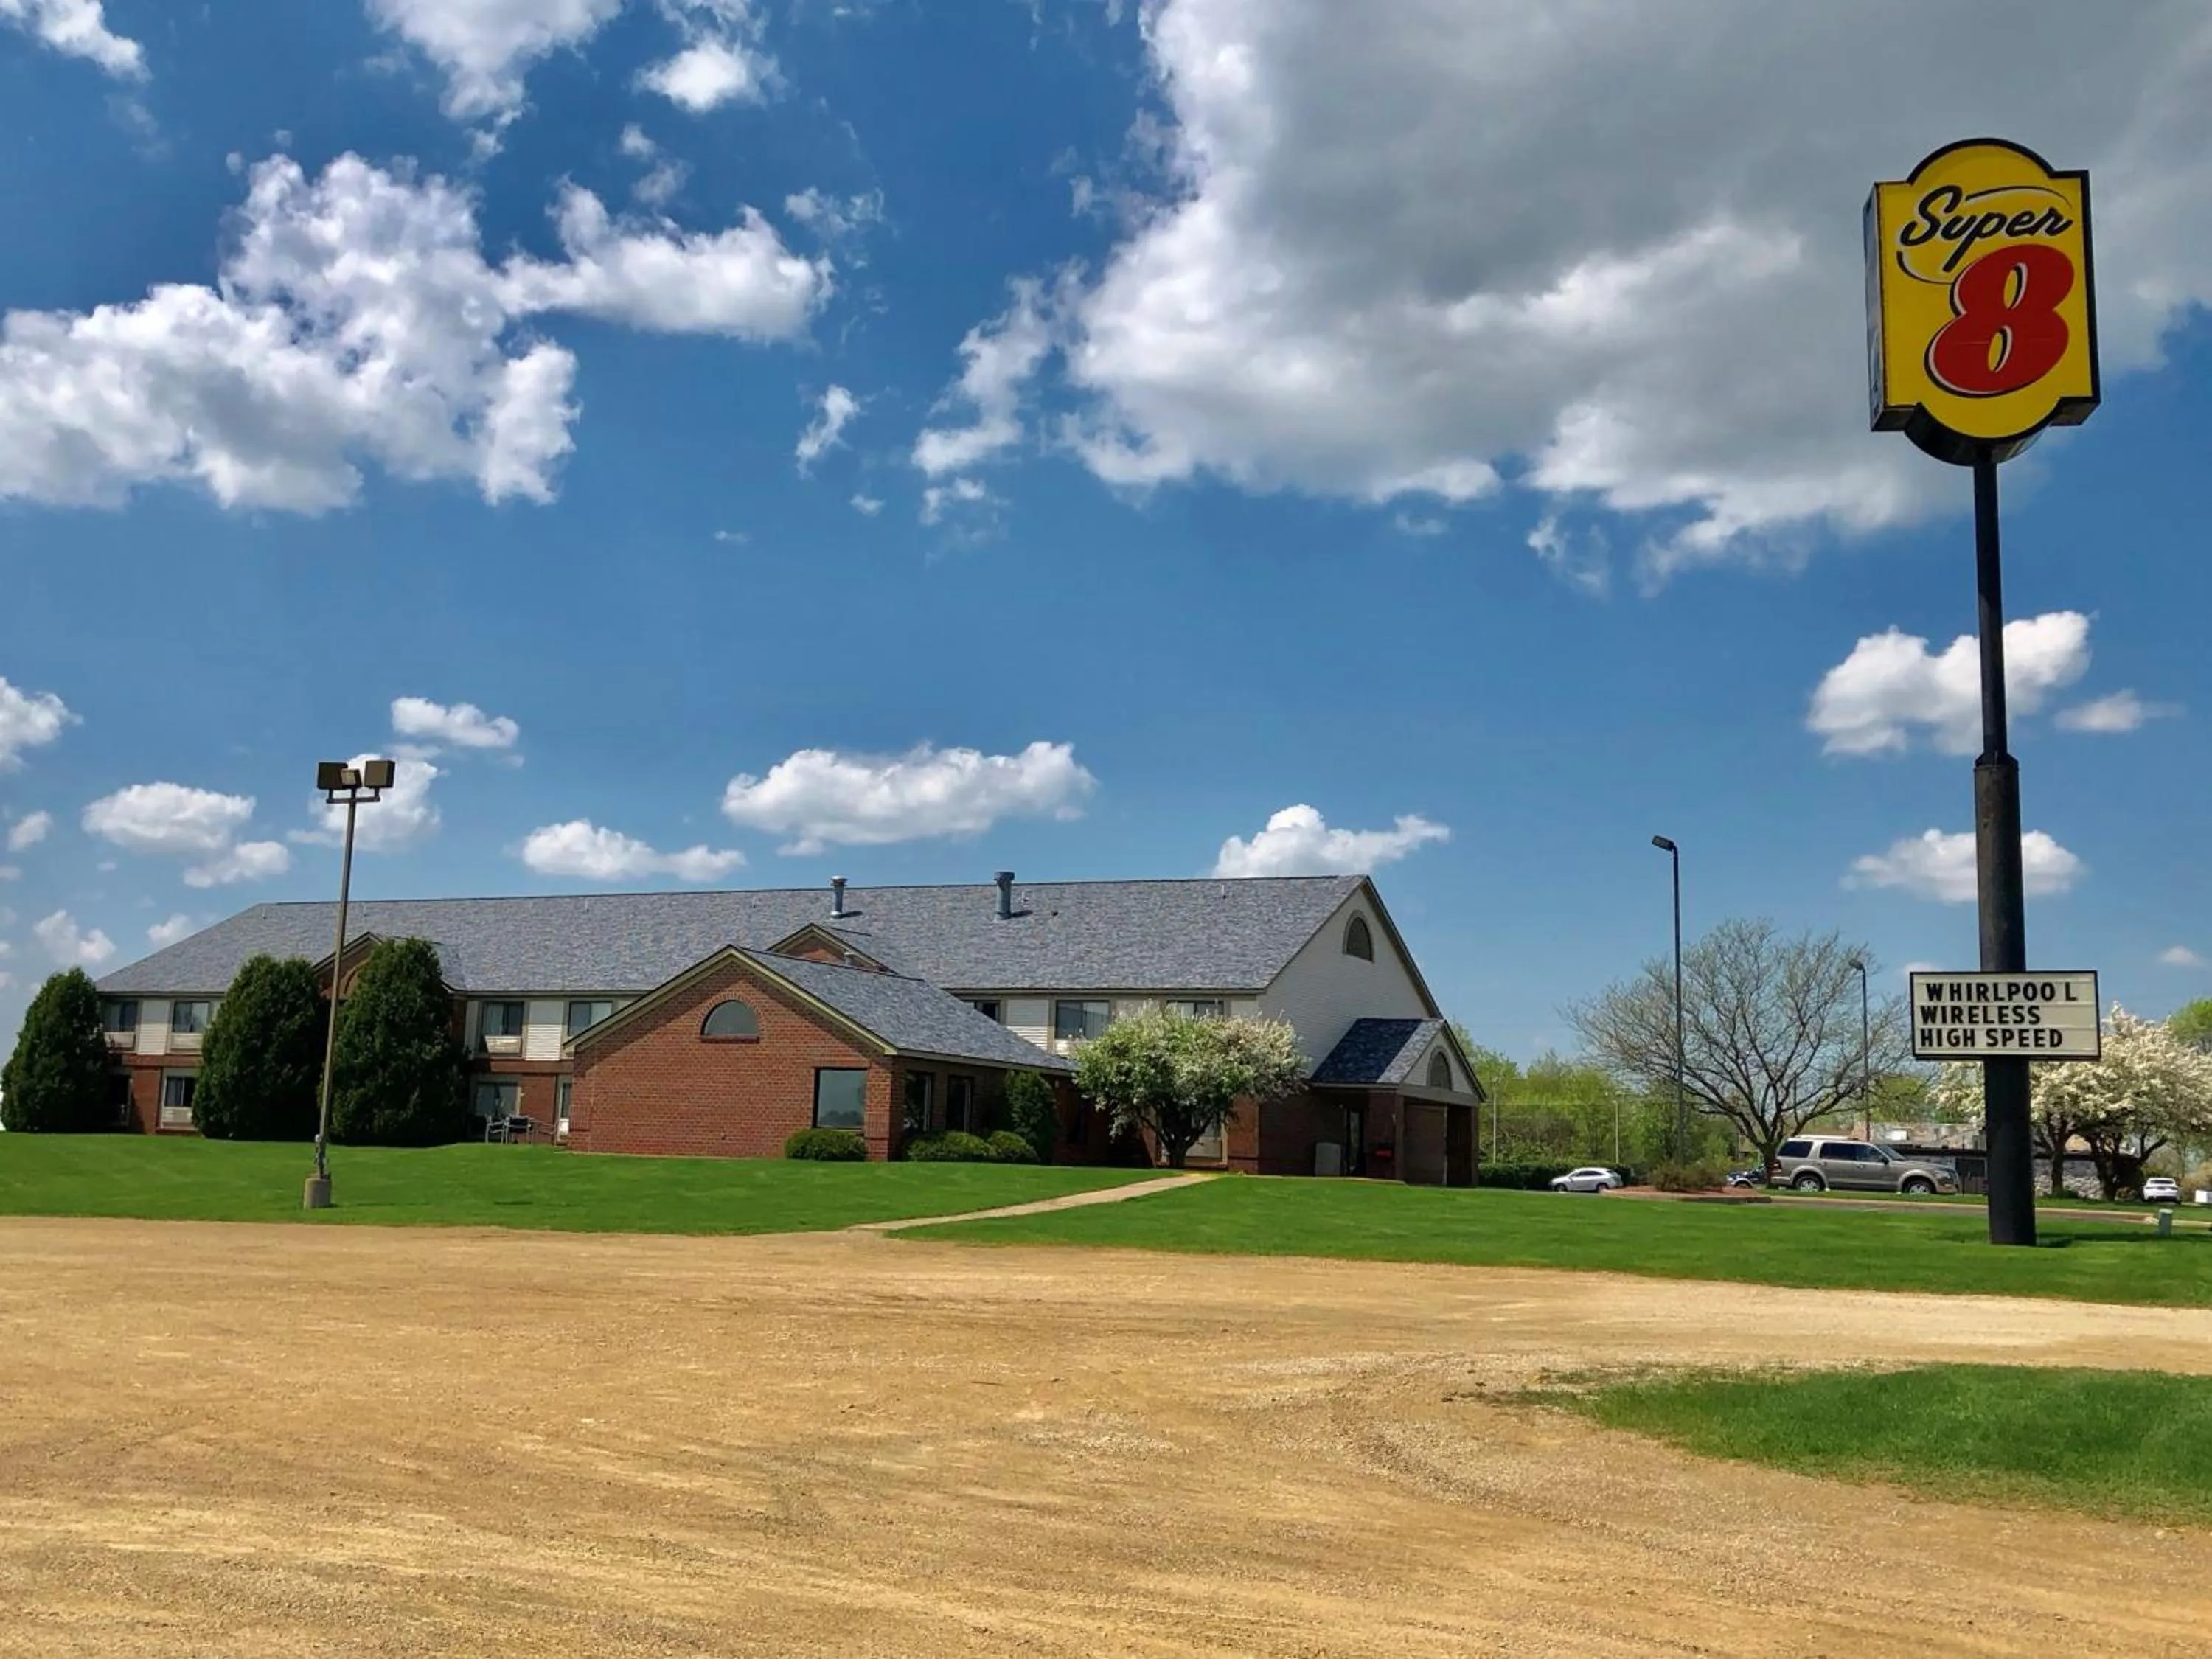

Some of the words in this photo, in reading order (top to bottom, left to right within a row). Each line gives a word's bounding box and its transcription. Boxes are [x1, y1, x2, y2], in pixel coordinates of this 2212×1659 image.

[1899, 184, 2074, 273] Super
[1924, 243, 2076, 399] 8
[1920, 1005, 2042, 1025] WIRELESS
[1920, 1029, 1975, 1048] HIGH
[1986, 1028, 2063, 1048] SPEED
